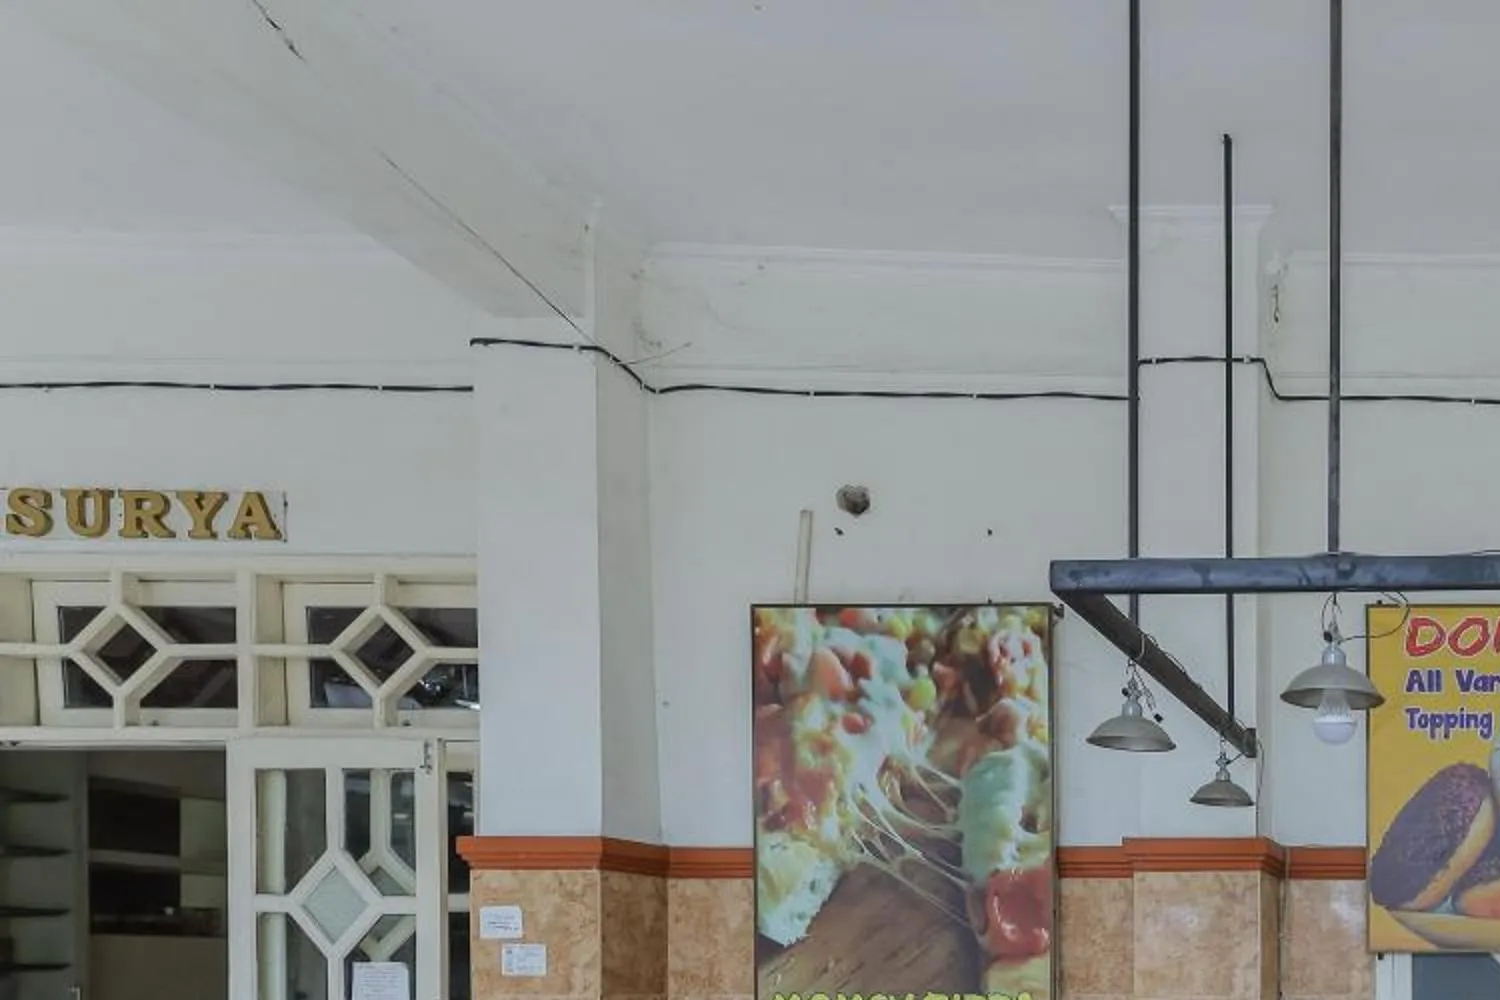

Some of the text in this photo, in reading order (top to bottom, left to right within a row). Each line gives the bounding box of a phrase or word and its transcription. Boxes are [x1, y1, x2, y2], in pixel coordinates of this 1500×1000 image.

[5, 487, 284, 540] SURYA
[1405, 669, 1441, 693] All
[1405, 707, 1493, 739] Topping
